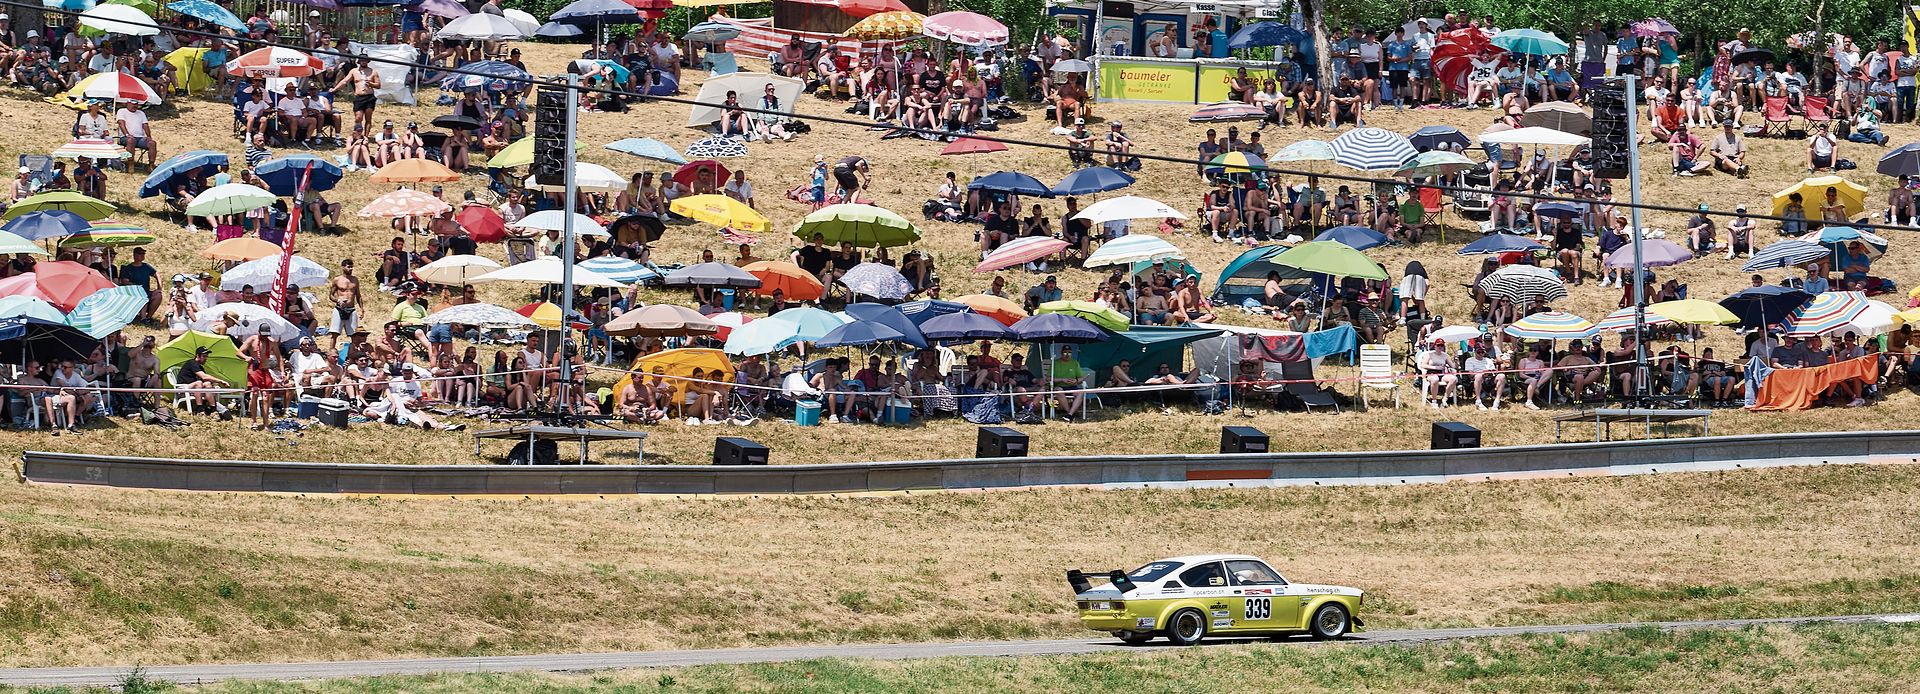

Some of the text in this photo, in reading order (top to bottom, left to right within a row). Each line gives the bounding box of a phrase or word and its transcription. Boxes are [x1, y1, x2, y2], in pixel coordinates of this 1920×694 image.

[1196, 3, 1216, 11] Kasse
[1262, 9, 1279, 17] Glac
[1120, 69, 1171, 82] baumeler
[1477, 67, 1491, 78] 26
[1245, 598, 1271, 619] 339
